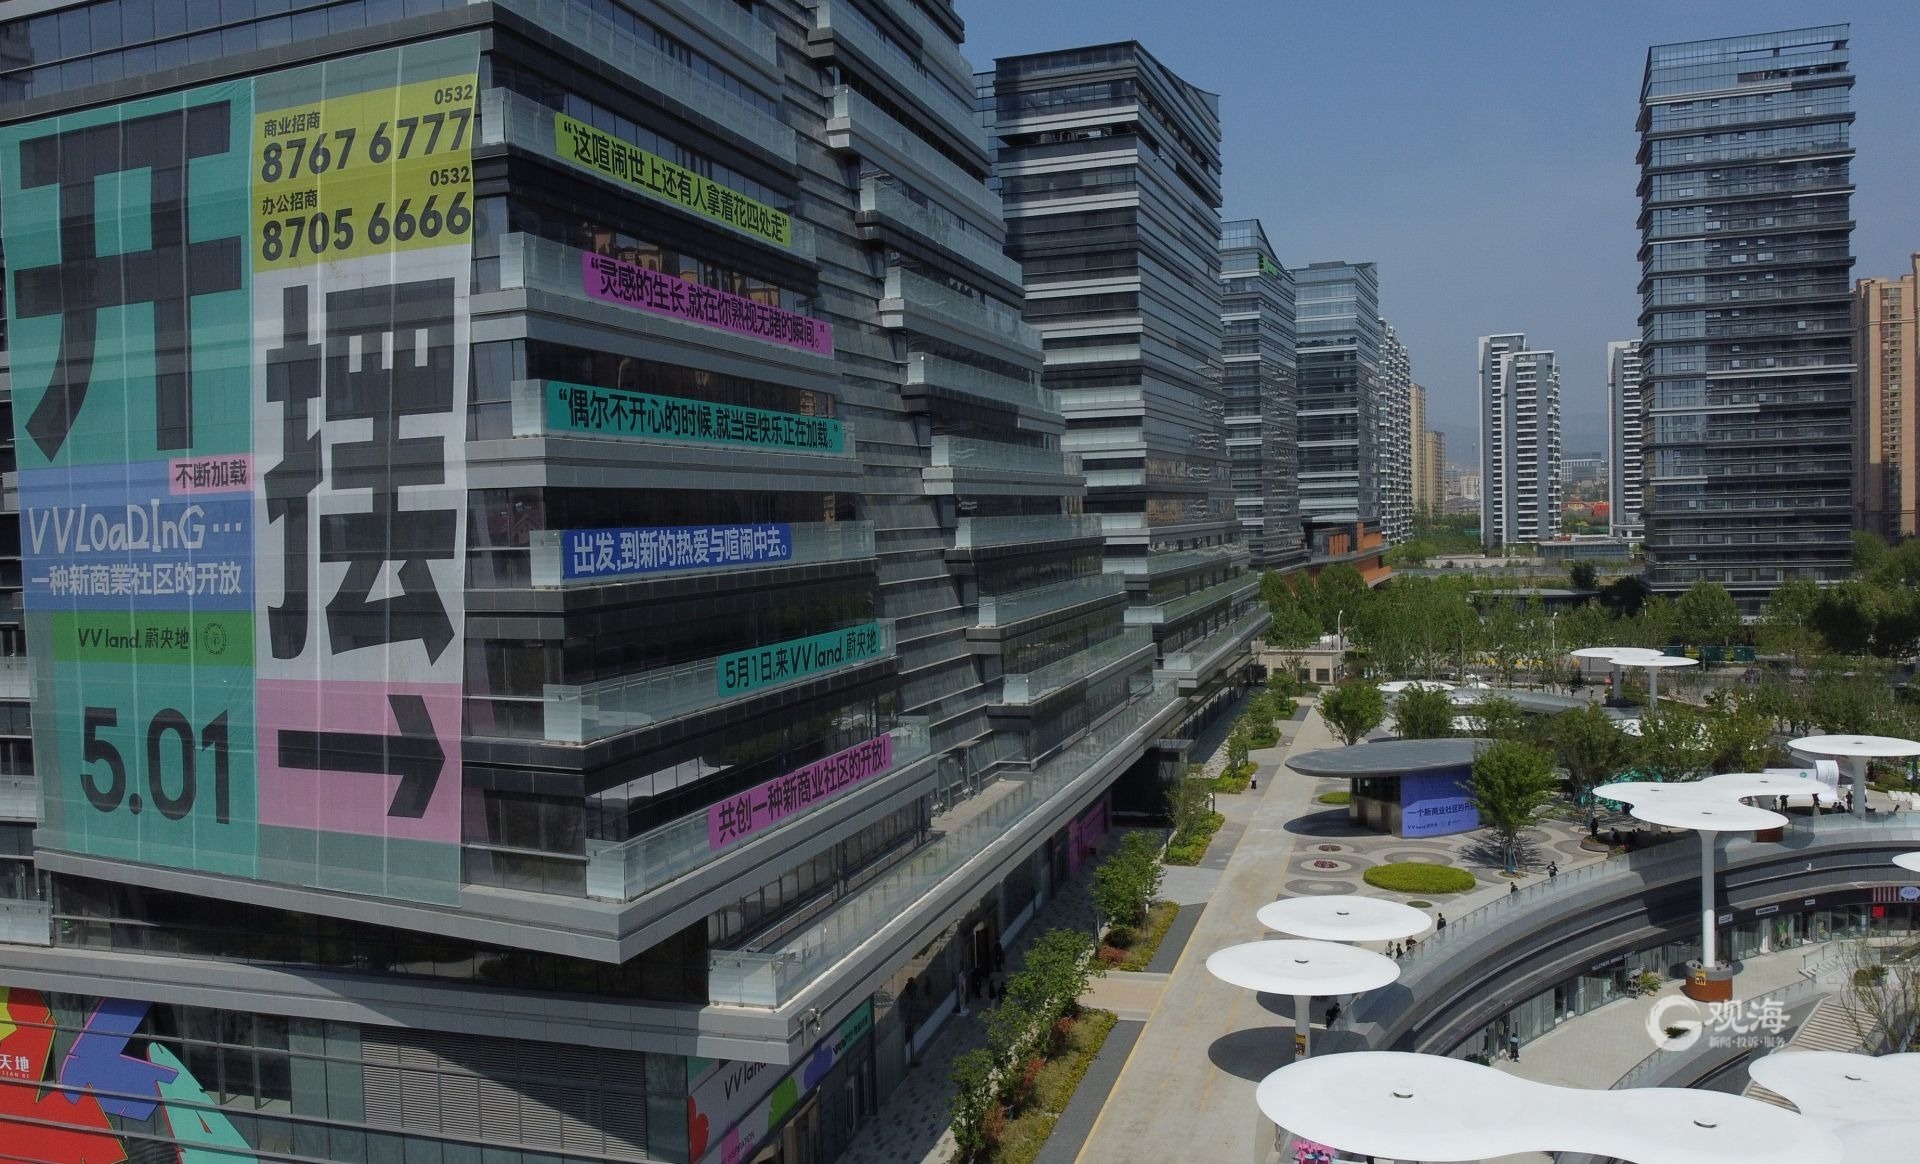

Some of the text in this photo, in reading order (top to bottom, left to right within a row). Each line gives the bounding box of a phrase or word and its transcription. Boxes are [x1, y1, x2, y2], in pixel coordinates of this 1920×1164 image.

[434, 84, 473, 105] 0532
[264, 111, 321, 139] 商业招商
[261, 107, 473, 183] 8767 6777
[430, 166, 471, 187] 0532
[262, 189, 318, 216] 办公招商
[262, 191, 472, 262] 8705 6666
[14, 100, 242, 463] 开
[175, 459, 247, 489] 不断加载
[32, 561, 242, 596] 一种新商業社区的开放
[144, 626, 189, 650] 蔚央地
[80, 706, 230, 825] 5.01
